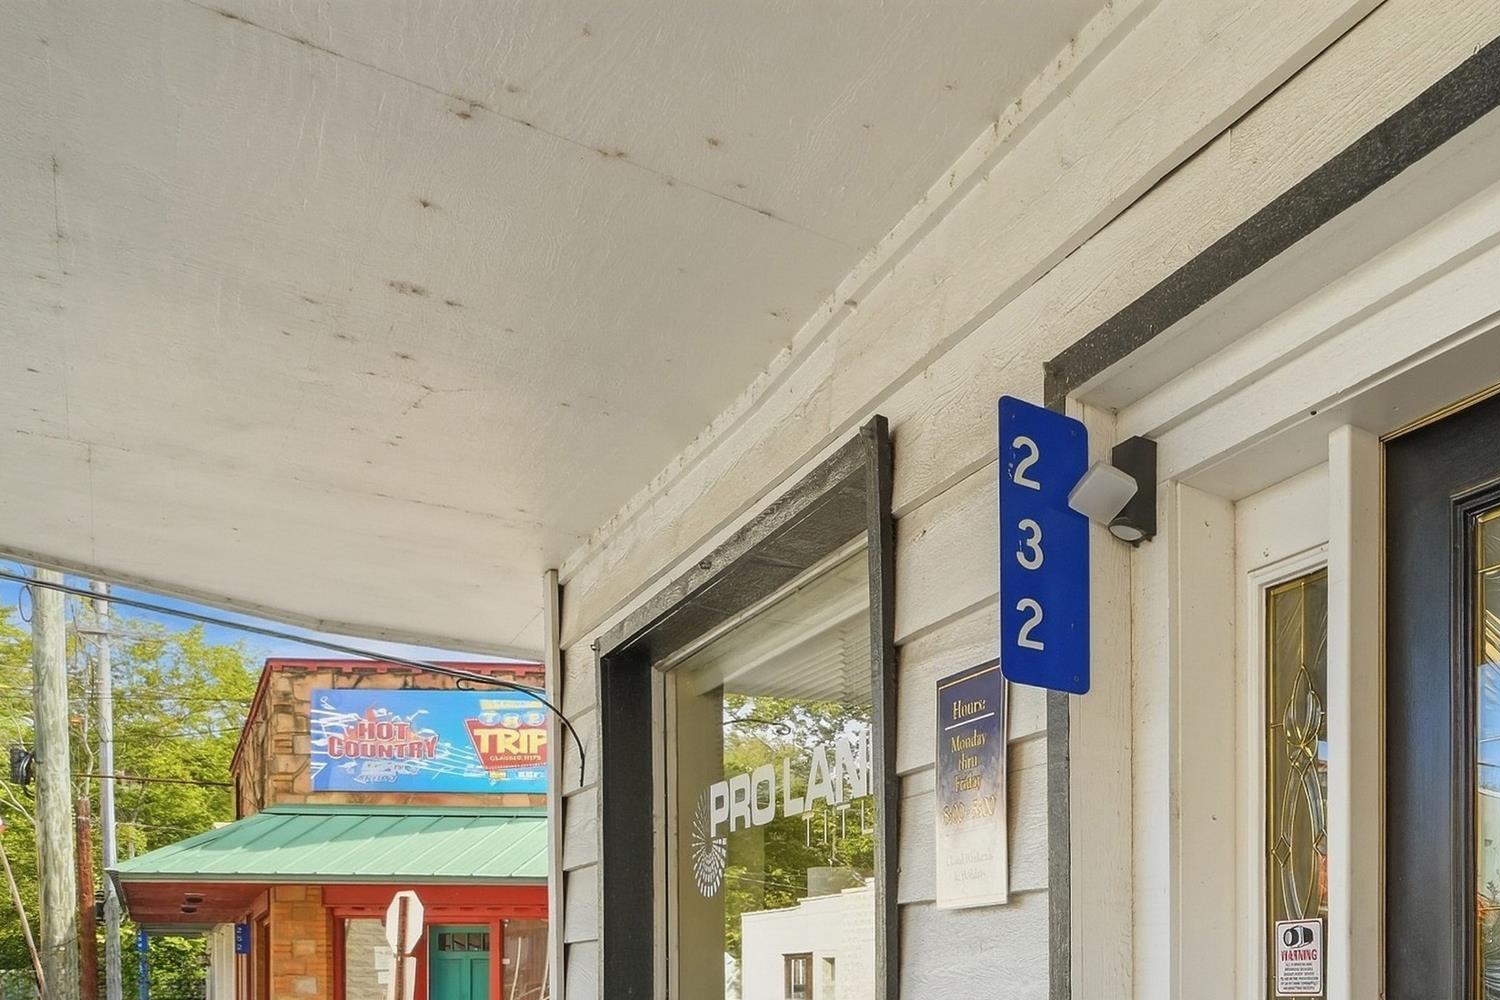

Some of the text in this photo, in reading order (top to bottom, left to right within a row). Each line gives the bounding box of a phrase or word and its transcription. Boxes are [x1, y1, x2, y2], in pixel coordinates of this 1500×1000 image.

[1012, 436, 1044, 651] 232
[357, 722, 409, 741] HOT
[474, 729, 547, 754] TRIP
[952, 730, 986, 753] Monday
[327, 736, 439, 759] COUNTRY
[711, 725, 873, 837] PRO LAN
